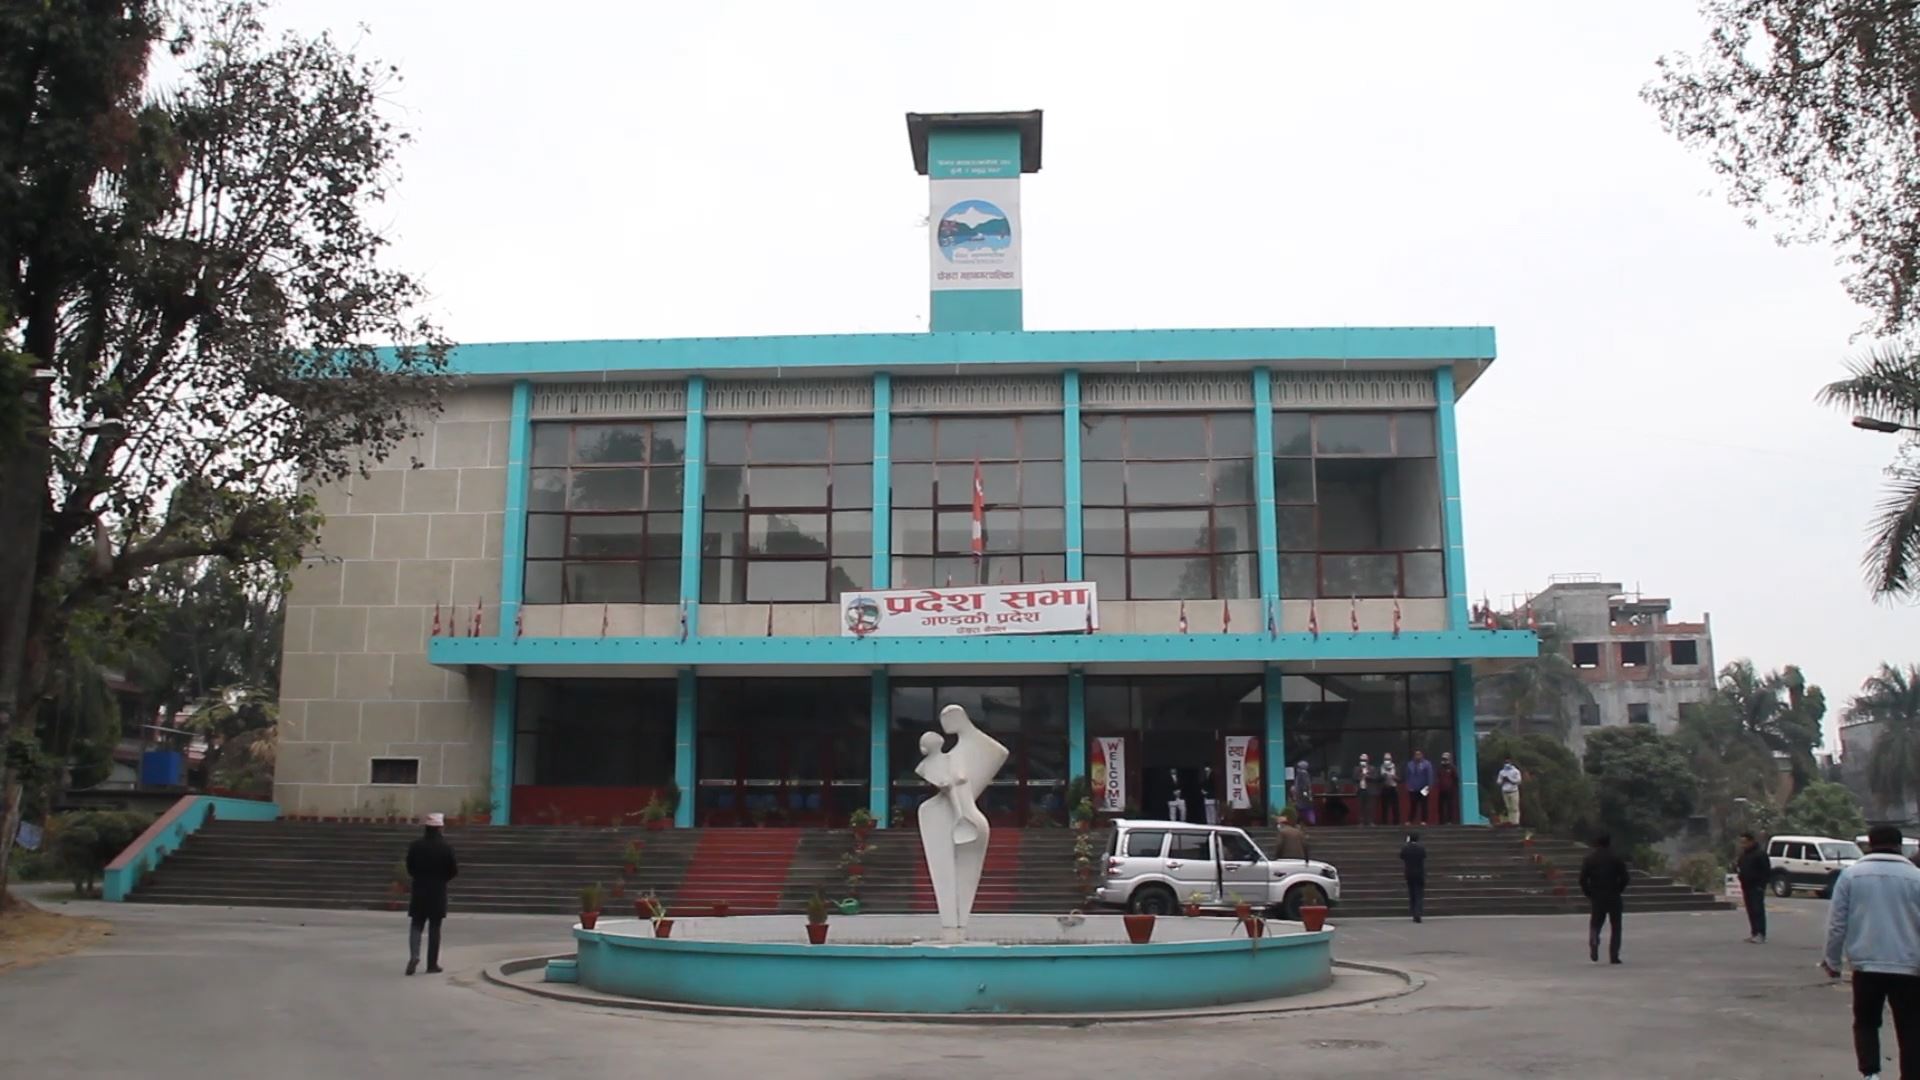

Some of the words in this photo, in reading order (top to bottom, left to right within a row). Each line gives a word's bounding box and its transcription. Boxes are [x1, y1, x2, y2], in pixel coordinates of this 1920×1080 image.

[884, 591, 985, 616] प्रदेश
[1000, 588, 1088, 609] सभा
[921, 611, 989, 626] गण्डकी
[997, 609, 1040, 624] प्रदेश
[1107, 742, 1119, 808] WELCOME
